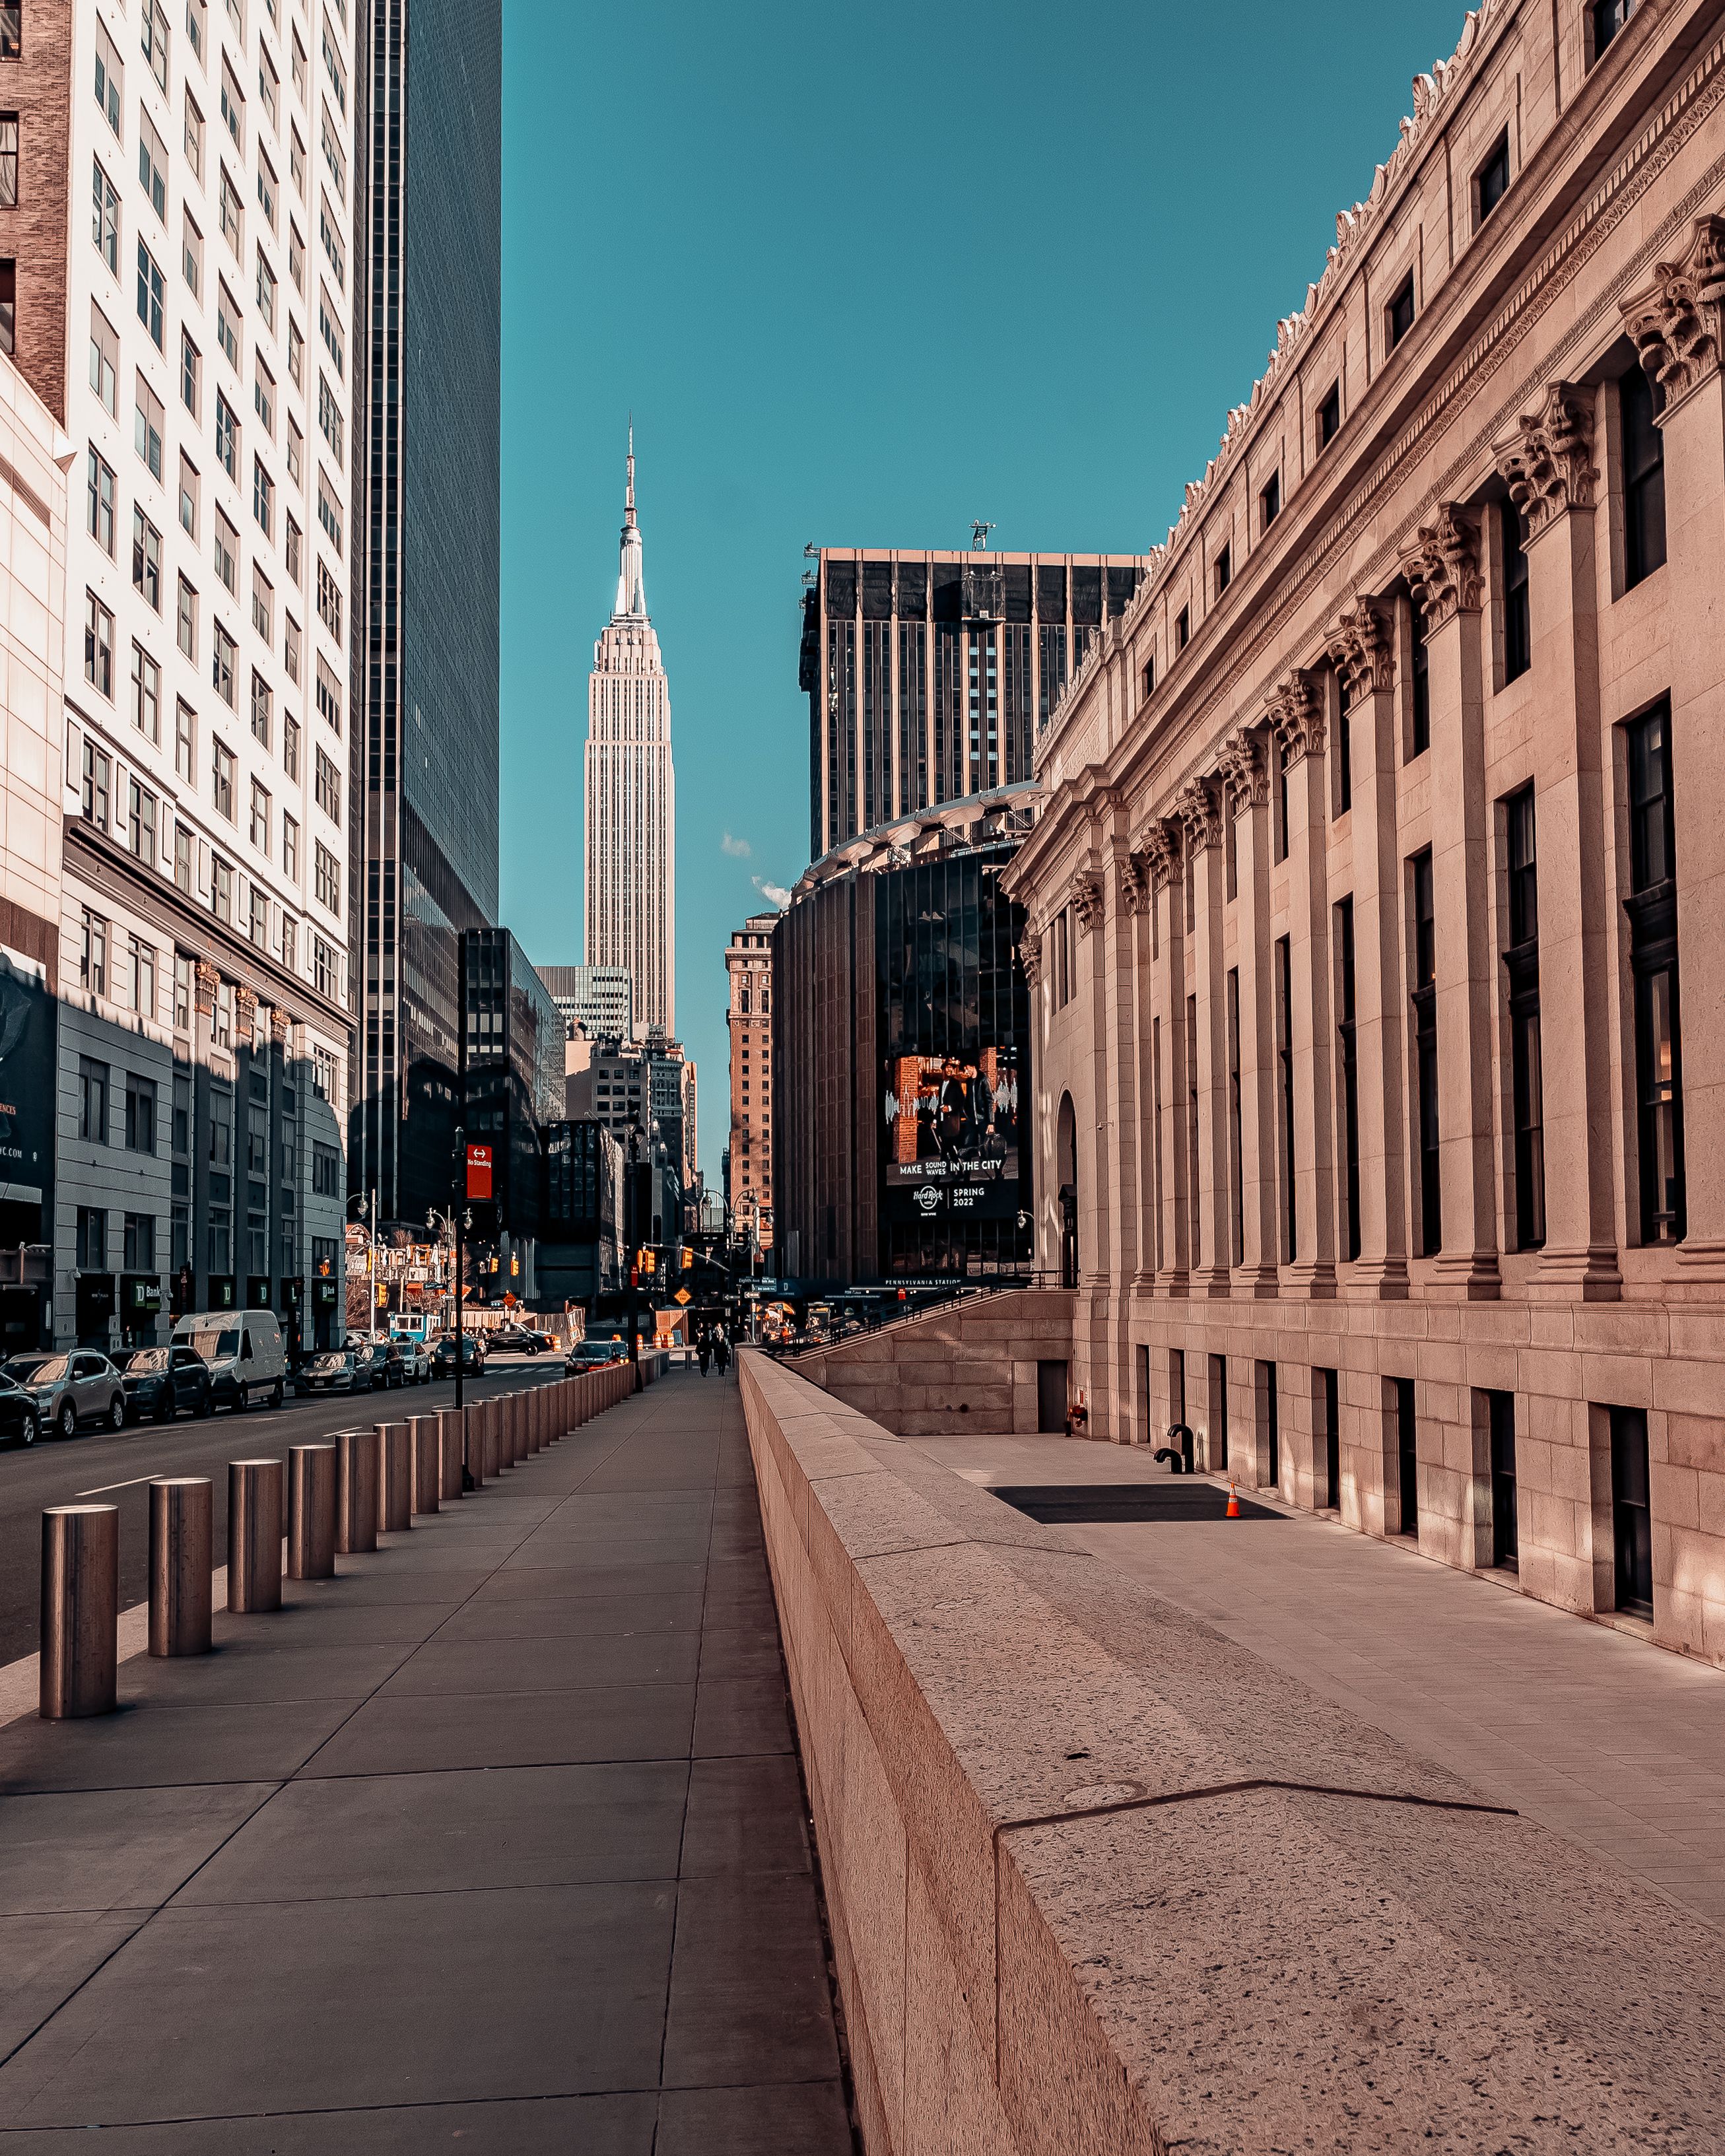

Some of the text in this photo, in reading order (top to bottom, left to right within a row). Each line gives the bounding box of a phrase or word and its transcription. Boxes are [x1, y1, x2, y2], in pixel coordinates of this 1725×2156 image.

[900, 1164, 922, 1174] MAKE
[951, 1160, 1001, 1172] IN THE CITY
[913, 1190, 943, 1200] Hard Rock
[954, 1188, 984, 1197] SPRING
[147, 1286, 160, 1297] Bank
